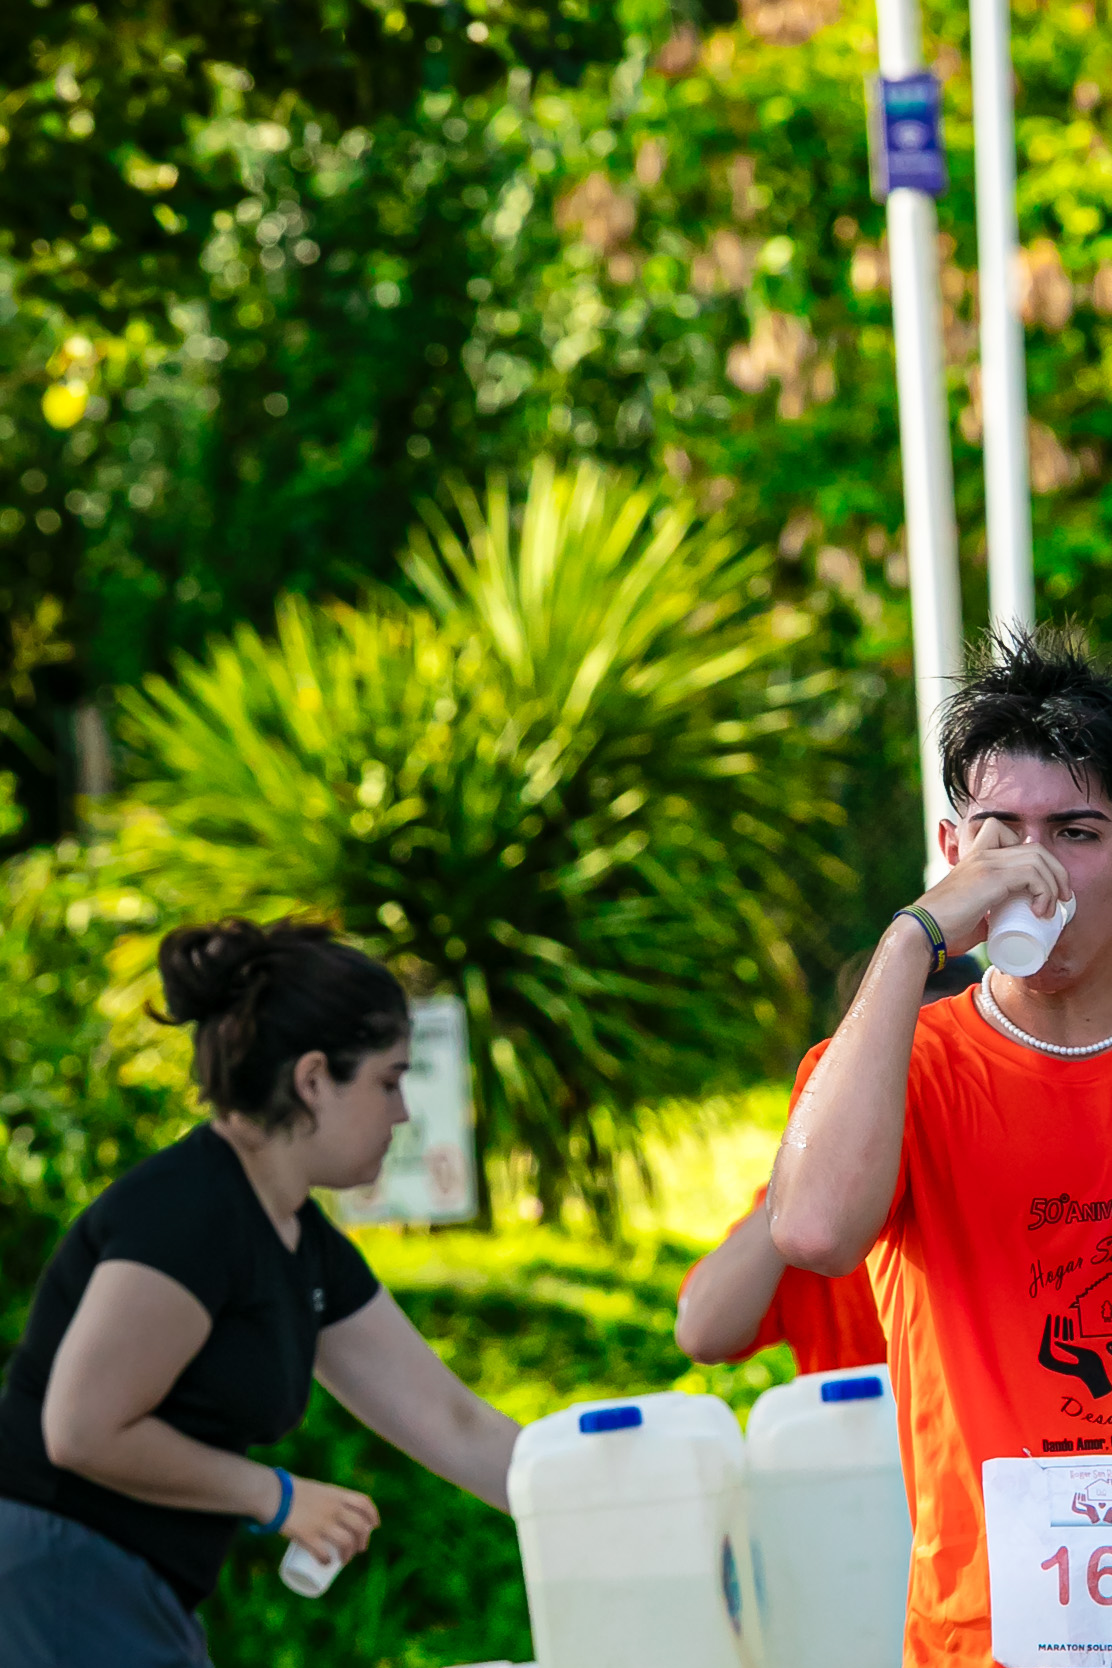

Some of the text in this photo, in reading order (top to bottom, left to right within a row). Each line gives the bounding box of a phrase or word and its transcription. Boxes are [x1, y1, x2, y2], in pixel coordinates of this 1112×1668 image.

[1029, 1257, 1084, 1299] Hogar
[1042, 1438, 1074, 1453] Dando
[1038, 1643, 1085, 1652] MARATON
